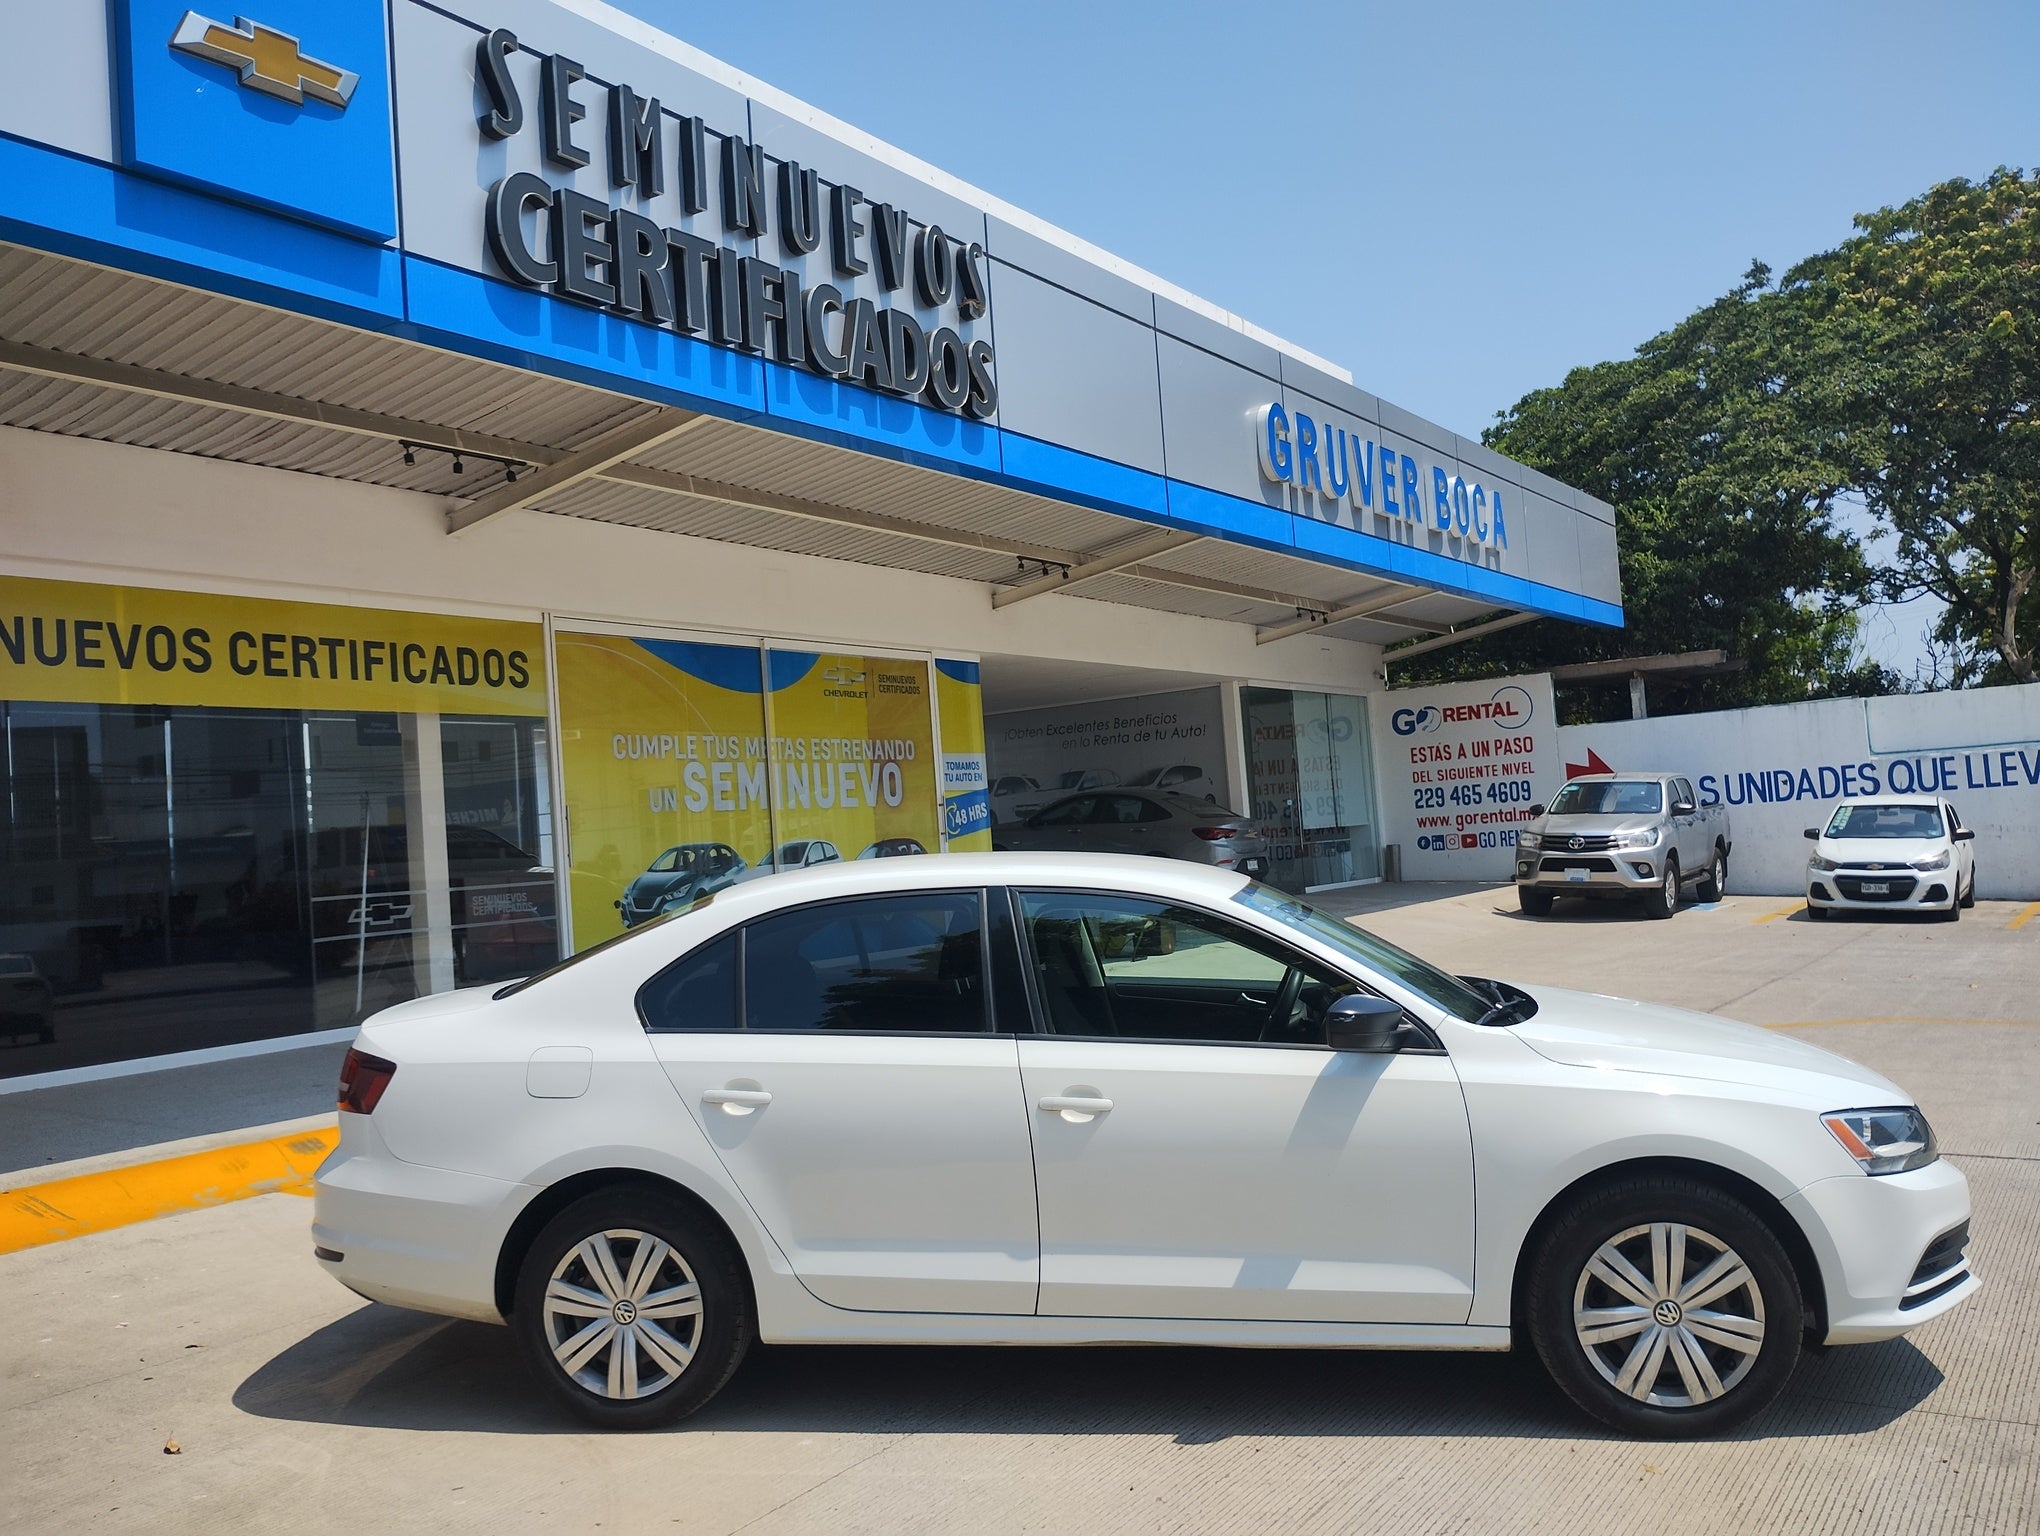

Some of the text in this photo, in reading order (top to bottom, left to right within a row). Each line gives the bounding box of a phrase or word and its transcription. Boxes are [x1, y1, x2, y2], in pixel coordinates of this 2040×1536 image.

[475, 28, 988, 321] SEMINUEVOS
[486, 172, 998, 418] CERTIFICADOS
[1257, 402, 1508, 550] GRUVER BOCA
[229, 632, 530, 689] CERTIFICADOS
[878, 673, 916, 685] SEMINUEVOS
[878, 685, 921, 695] CERTIFICADOS
[823, 689, 869, 699] CHEVROLET
[1442, 701, 1519, 723] RENTAL
[1046, 720, 1110, 736] Excelentes
[1113, 712, 1177, 729] Beneficios
[613, 734, 697, 760] CUMPLE
[702, 735, 738, 760] TUS
[810, 738, 915, 761] ESTRENANDO
[1062, 724, 1206, 749] en la Renta de tu Auto!
[1457, 742, 1467, 759] A
[1472, 740, 1490, 758] UN
[1494, 736, 1534, 757] PASO
[944, 773, 983, 782] TU AUTO EN
[946, 761, 980, 771] TOMAMOS
[1412, 761, 1535, 784] DEL SIGUIENTE NIVEL
[648, 761, 903, 813] UN SEMINUEVO
[1725, 762, 1880, 805] UNIDADES
[1888, 756, 1958, 794] QUE
[1414, 780, 1532, 809] 229 465 4609
[955, 802, 988, 825] 48 HRS
[1478, 831, 1496, 848] GO
[472, 892, 528, 906] SEMINUEVOS
[473, 902, 534, 916] CERTIFICADOS
